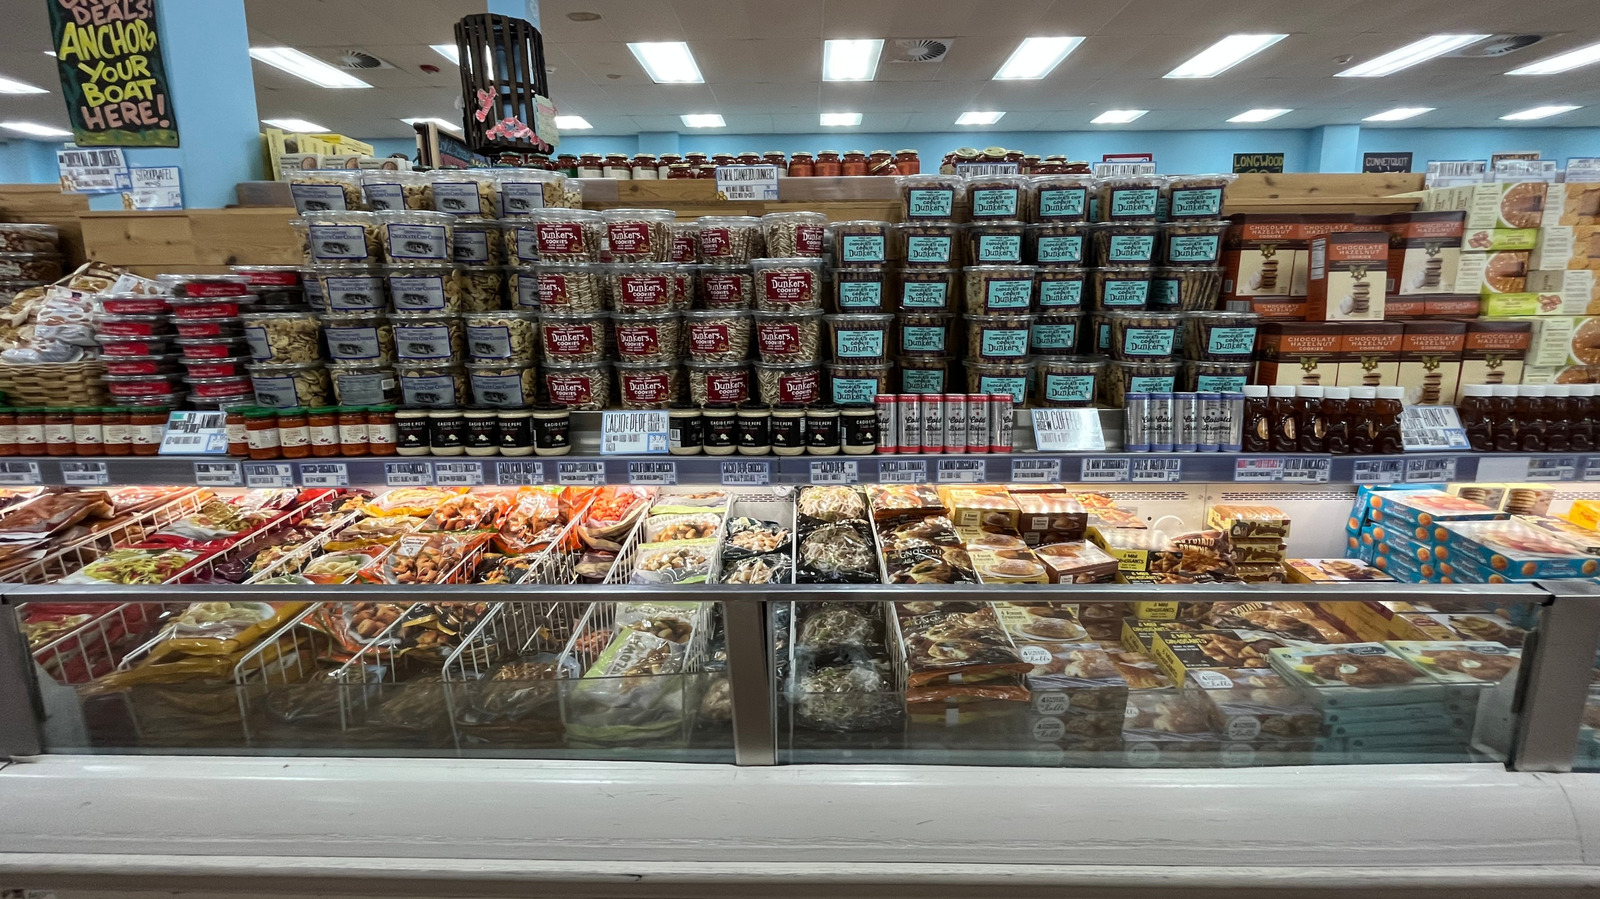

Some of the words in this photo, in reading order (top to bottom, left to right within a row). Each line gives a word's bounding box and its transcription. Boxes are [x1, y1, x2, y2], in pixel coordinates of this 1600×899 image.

[73, 0, 152, 25] DEALS!
[58, 19, 156, 60] ANCHOR
[78, 55, 151, 83] YOUR
[81, 78, 156, 107] BOAT
[81, 94, 170, 129] HERE!
[1234, 155, 1284, 167] LONGWOOD
[605, 413, 625, 433] CACIO
[630, 413, 647, 432] PEPE
[900, 549, 942, 559] GNOCCHI
